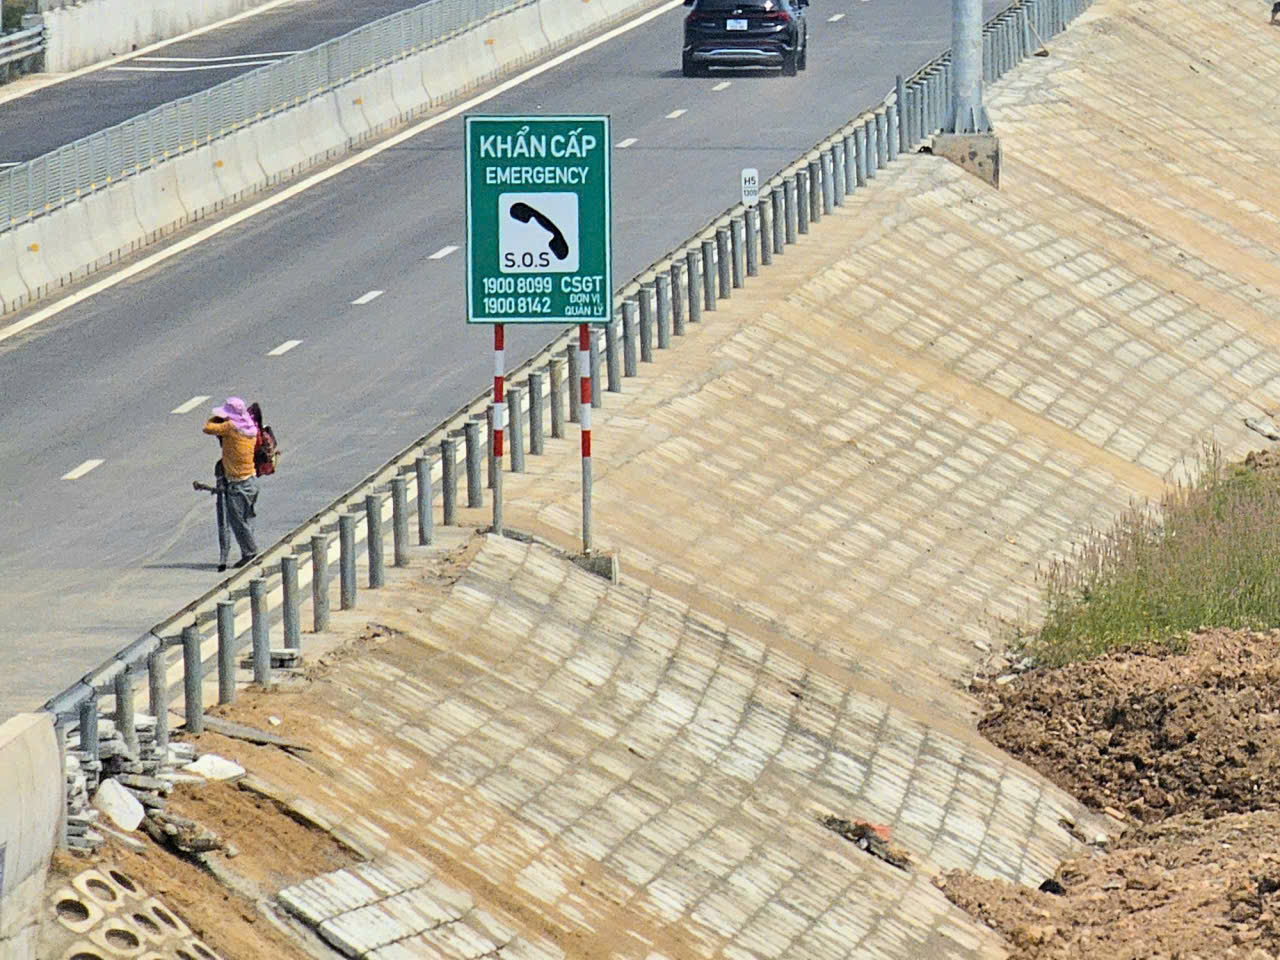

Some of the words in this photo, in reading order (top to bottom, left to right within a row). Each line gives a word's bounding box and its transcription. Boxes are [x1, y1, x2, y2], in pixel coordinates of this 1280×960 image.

[480, 125, 546, 158] KHẨN
[550, 127, 597, 158] CẤP
[486, 166, 589, 185] EMERGENCY
[504, 251, 550, 268] S.O.S
[483, 277, 514, 294] 1900
[516, 276, 552, 294] 8099
[561, 276, 603, 292] CSGT
[483, 297, 515, 314] 1900
[517, 297, 552, 314] 8142
